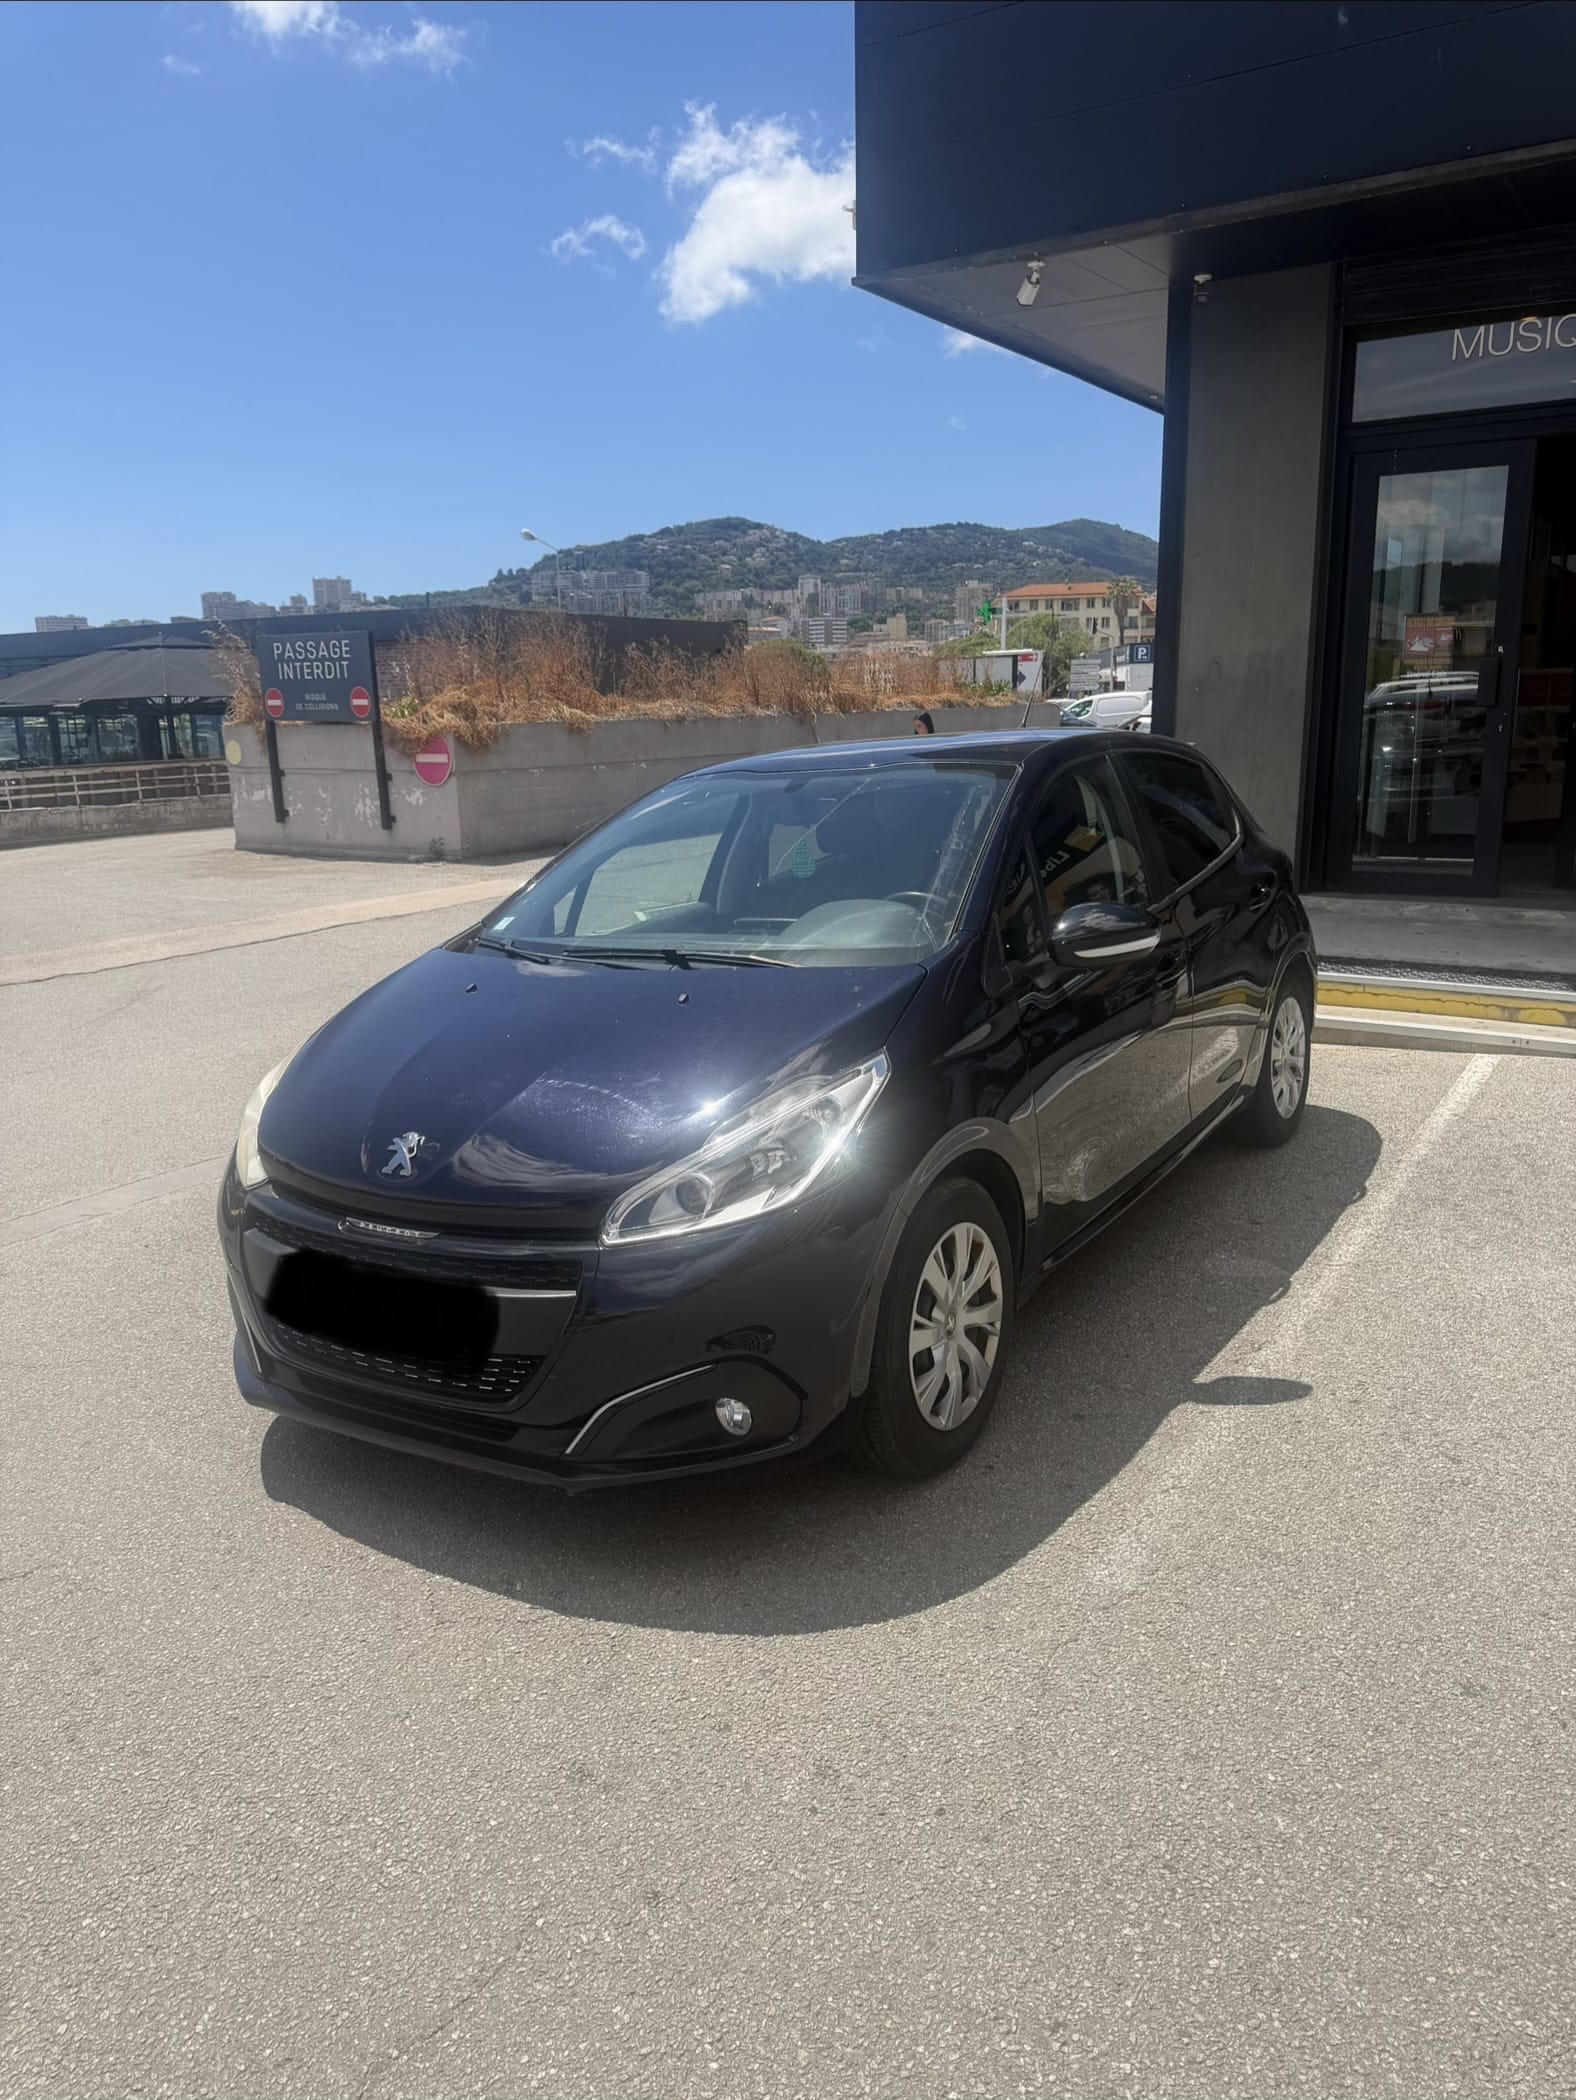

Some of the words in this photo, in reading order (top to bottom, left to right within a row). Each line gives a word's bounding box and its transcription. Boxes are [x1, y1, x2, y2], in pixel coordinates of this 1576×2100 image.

[273, 640, 351, 660] PASSAGE
[278, 661, 350, 680] INTERDIT
[304, 693, 327, 701] RISQUE
[295, 703, 303, 711] DE
[304, 703, 339, 711] COLLISIONS
[360, 1221, 420, 1238] PEUGEOT
